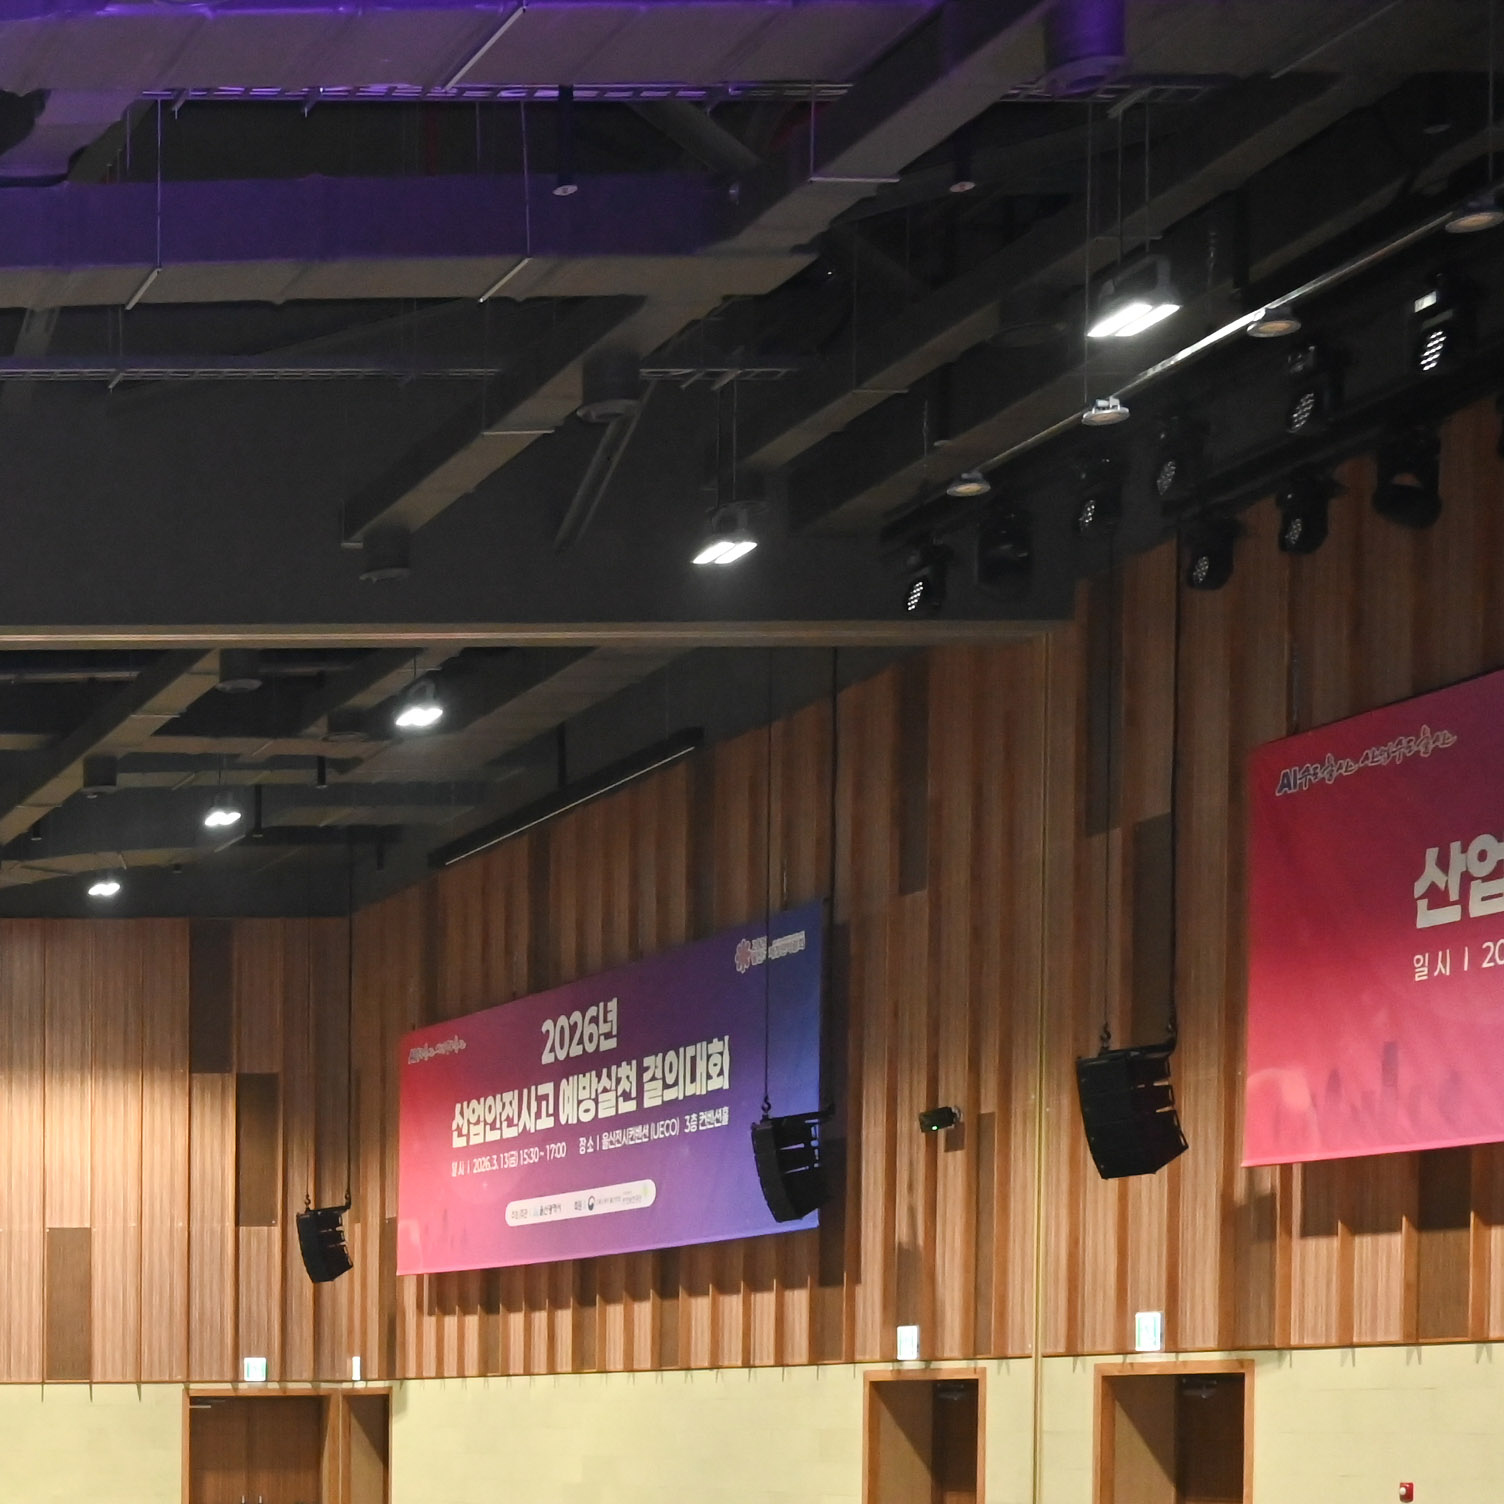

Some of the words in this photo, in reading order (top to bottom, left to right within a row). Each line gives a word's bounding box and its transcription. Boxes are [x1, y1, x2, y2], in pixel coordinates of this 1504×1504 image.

[540, 996, 619, 1065] 2026년
[451, 1080, 555, 1149] 산업안전사고
[558, 1058, 637, 1126] 예방실천
[642, 1034, 731, 1100] 결의대회
